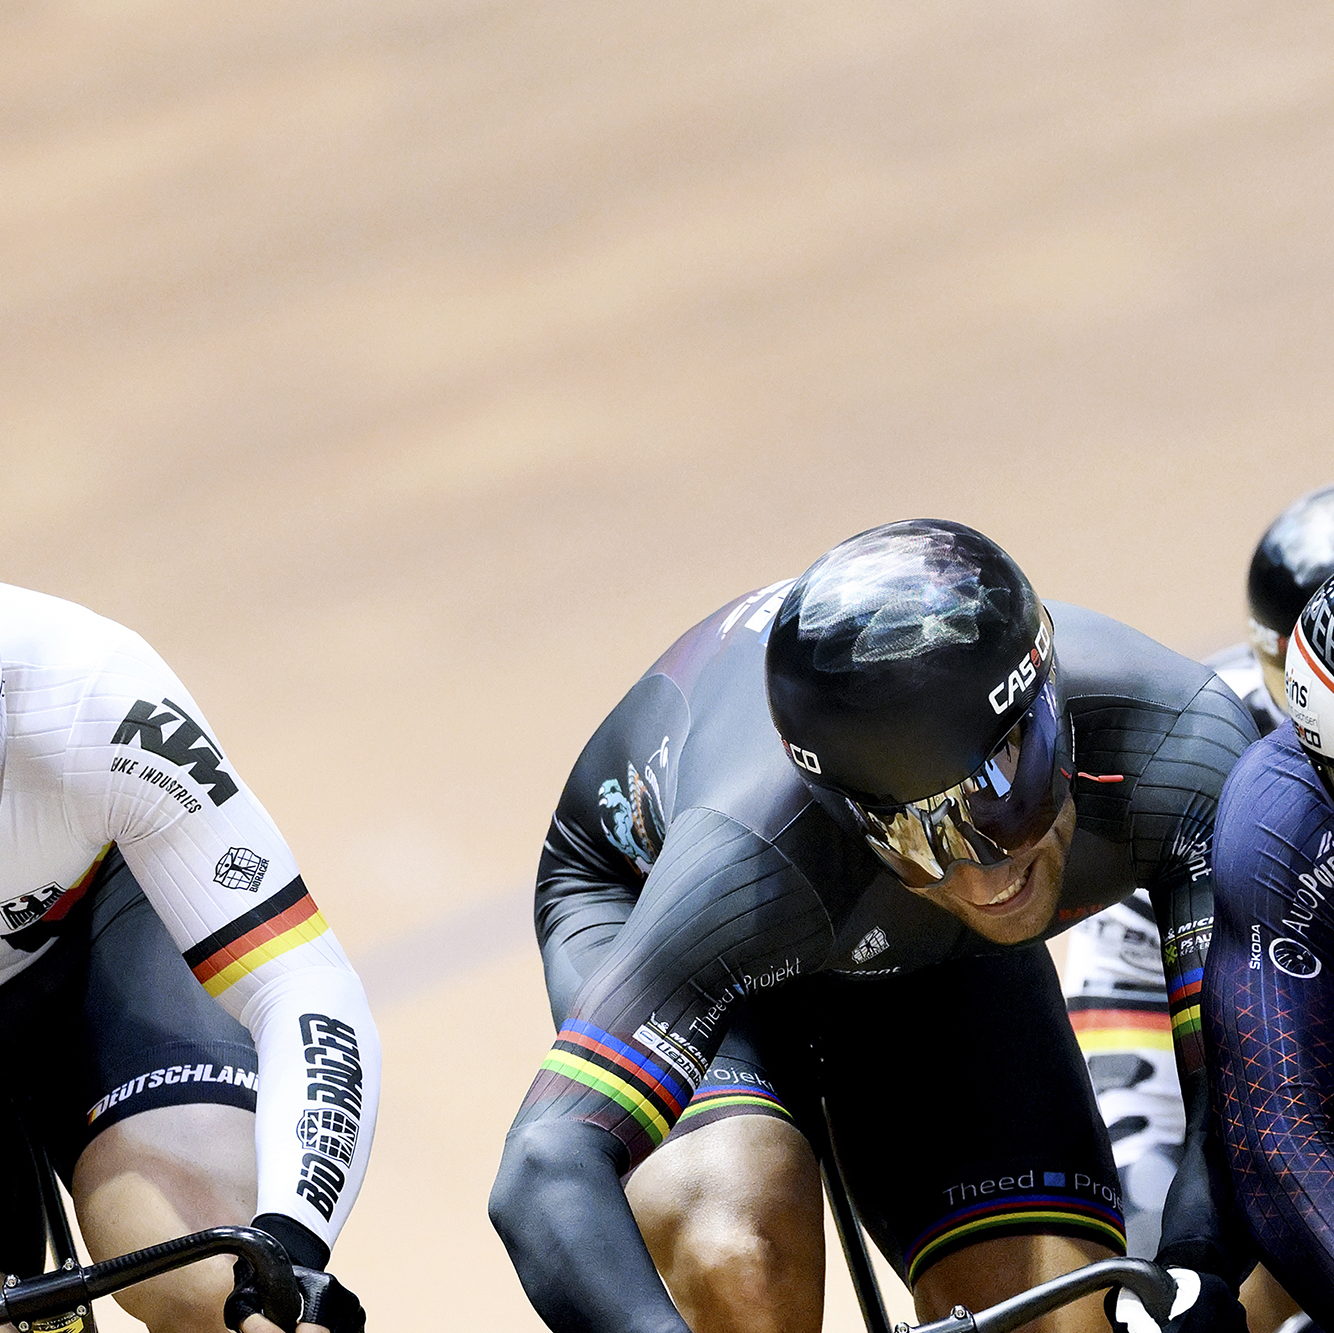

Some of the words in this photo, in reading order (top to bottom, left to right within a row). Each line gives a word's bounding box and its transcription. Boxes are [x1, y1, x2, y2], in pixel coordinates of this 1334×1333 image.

[987, 621, 1051, 715] CASCO
[110, 698, 239, 807] KTM
[139, 765, 202, 814] INDUSTRIES
[249, 858, 270, 893] BIORACER
[688, 988, 735, 1039] Theed
[743, 957, 802, 990] Projekt
[669, 1031, 709, 1070] MICHEL
[88, 1063, 259, 1126] DEUTSCHLAN
[703, 1066, 778, 1096] rojekt
[942, 1169, 1035, 1206] Theed
[1074, 1173, 1124, 1211] Proje
